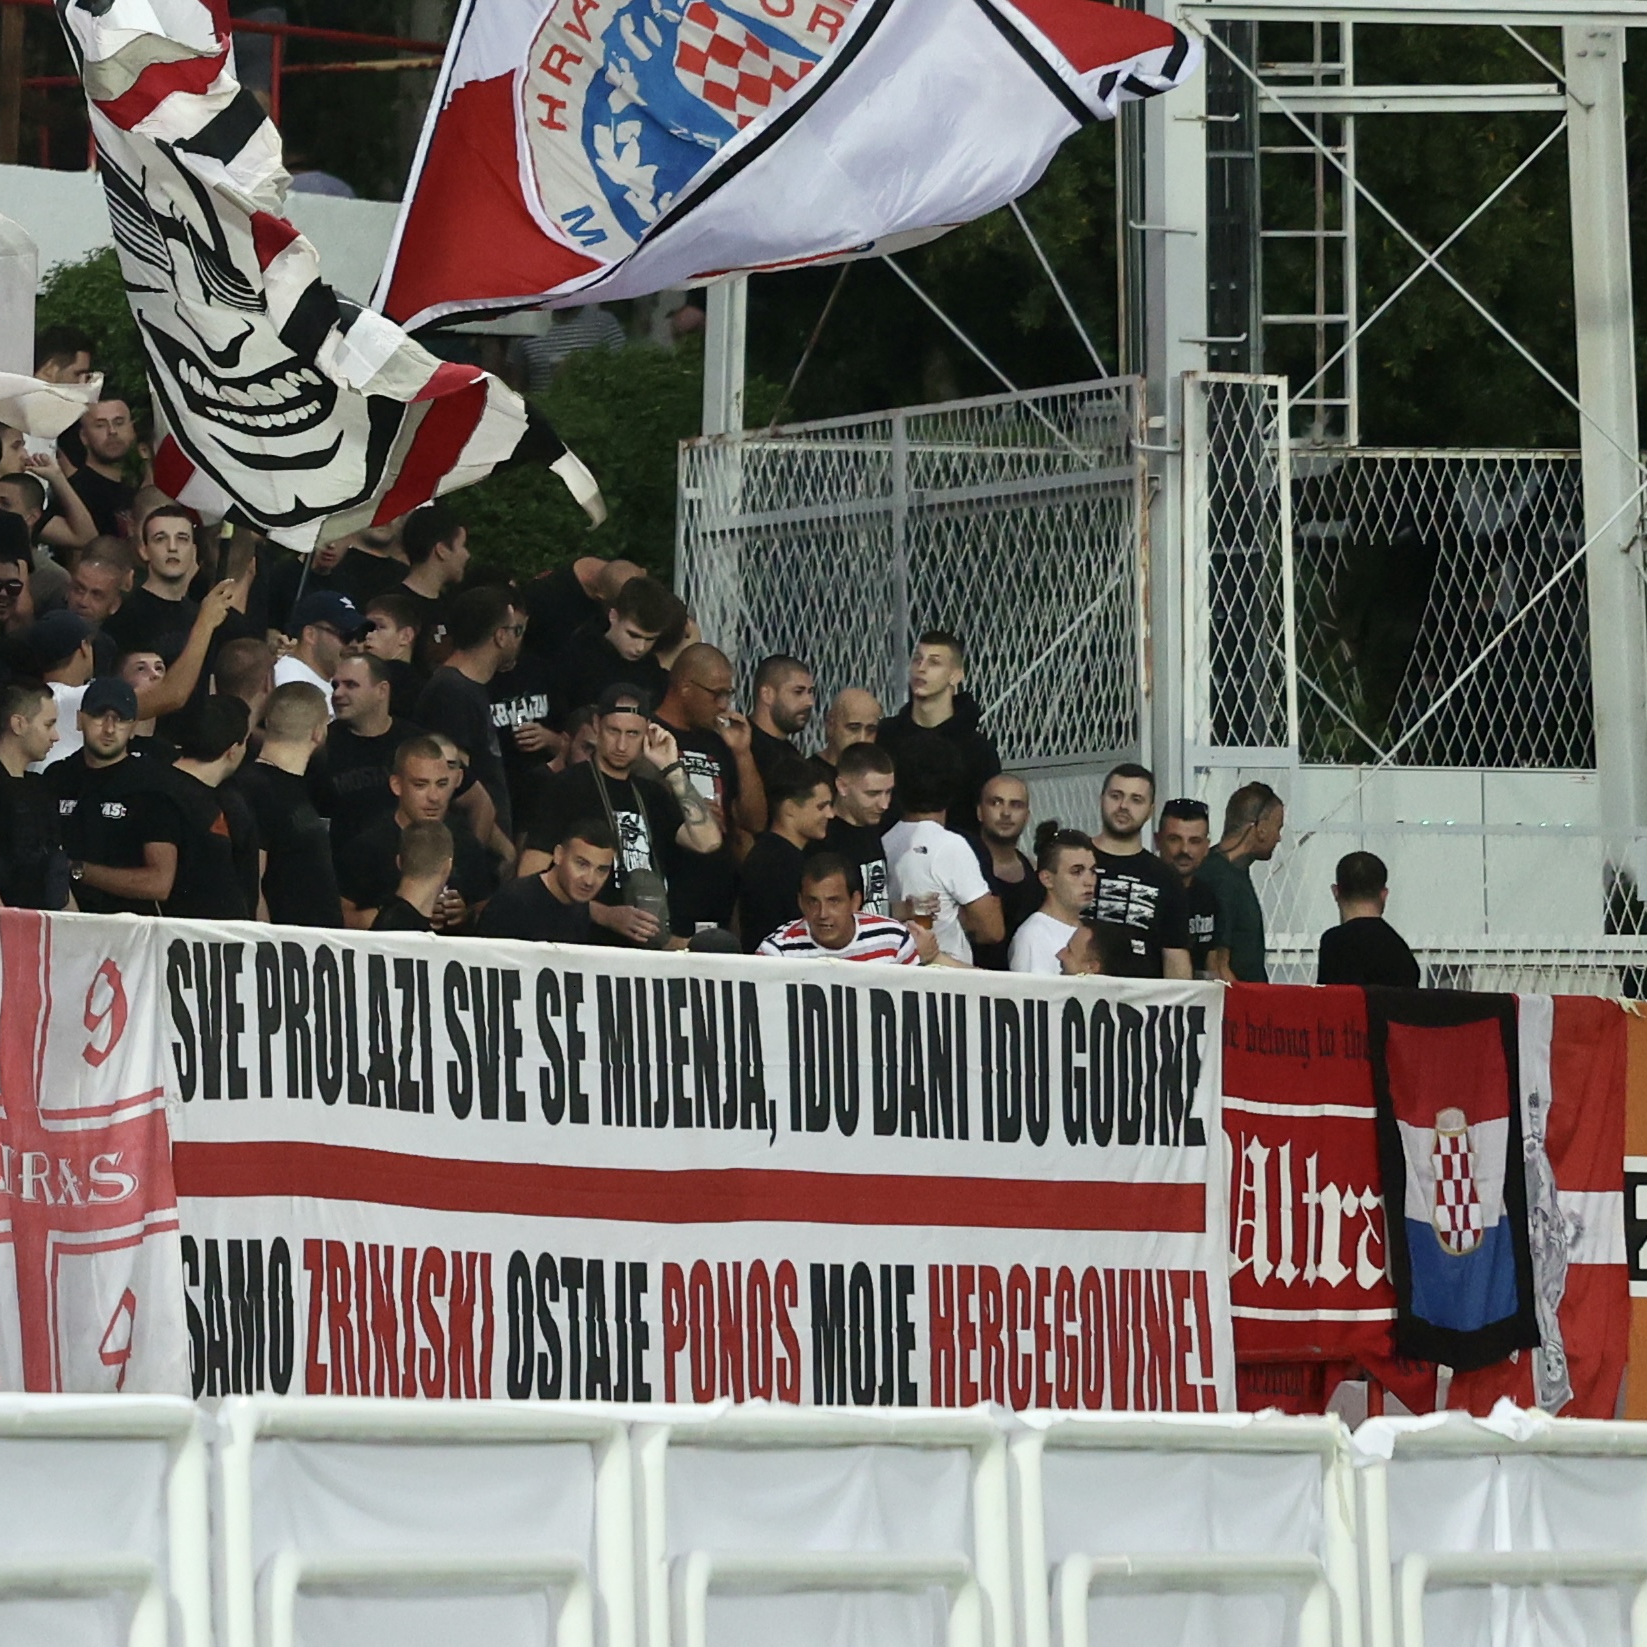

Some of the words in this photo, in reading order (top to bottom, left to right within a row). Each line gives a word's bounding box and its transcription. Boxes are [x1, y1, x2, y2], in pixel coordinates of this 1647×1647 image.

[166, 938, 247, 1102] SVE
[255, 941, 435, 1114] PROLAZI
[443, 960, 526, 1122] SVE
[536, 968, 589, 1125] SE
[596, 975, 776, 1148] MIJENJA,
[786, 983, 859, 1137] IDU
[869, 988, 969, 1141] DANI
[980, 996, 1050, 1147] IDU
[1061, 997, 1206, 1147] GODINE
[180, 1235, 294, 1400] SAMO
[303, 1238, 494, 1400] ZRINJSKI
[506, 1250, 651, 1403] OSTAJE
[662, 1259, 801, 1406] PONOS
[810, 1261, 918, 1408] MOJE
[928, 1263, 1218, 1413] HERCEGOVINE!
